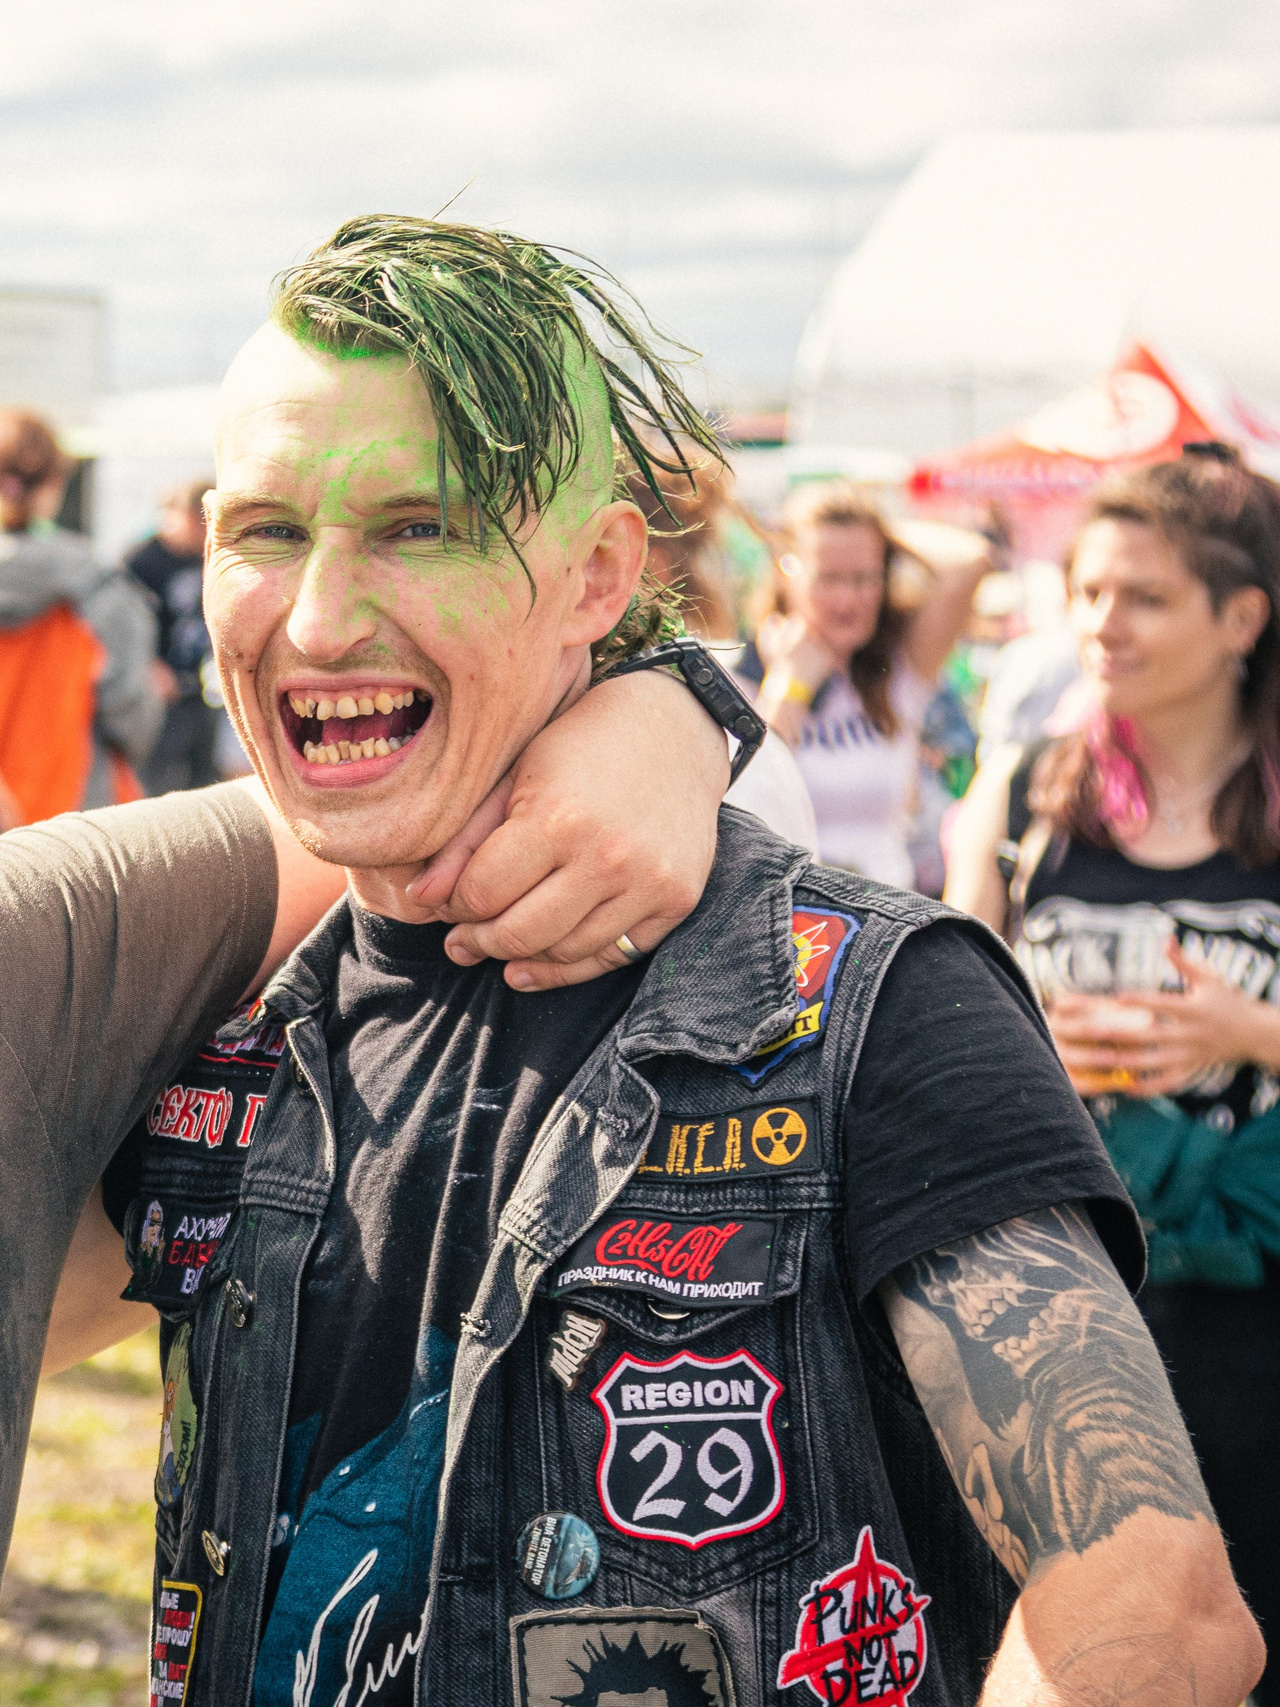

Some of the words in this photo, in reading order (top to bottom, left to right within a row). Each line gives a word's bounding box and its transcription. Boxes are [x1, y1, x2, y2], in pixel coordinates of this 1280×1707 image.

[558, 1266, 634, 1287] ПРАЗДНИК
[635, 1270, 648, 1284] К
[648, 1275, 680, 1295] НАМ
[682, 1282, 764, 1300] ПРИХОДИТ
[621, 1379, 756, 1411] REGION
[629, 1427, 755, 1522] 29
[843, 1630, 899, 1668] NOT
[821, 1650, 920, 1707] DEAD
